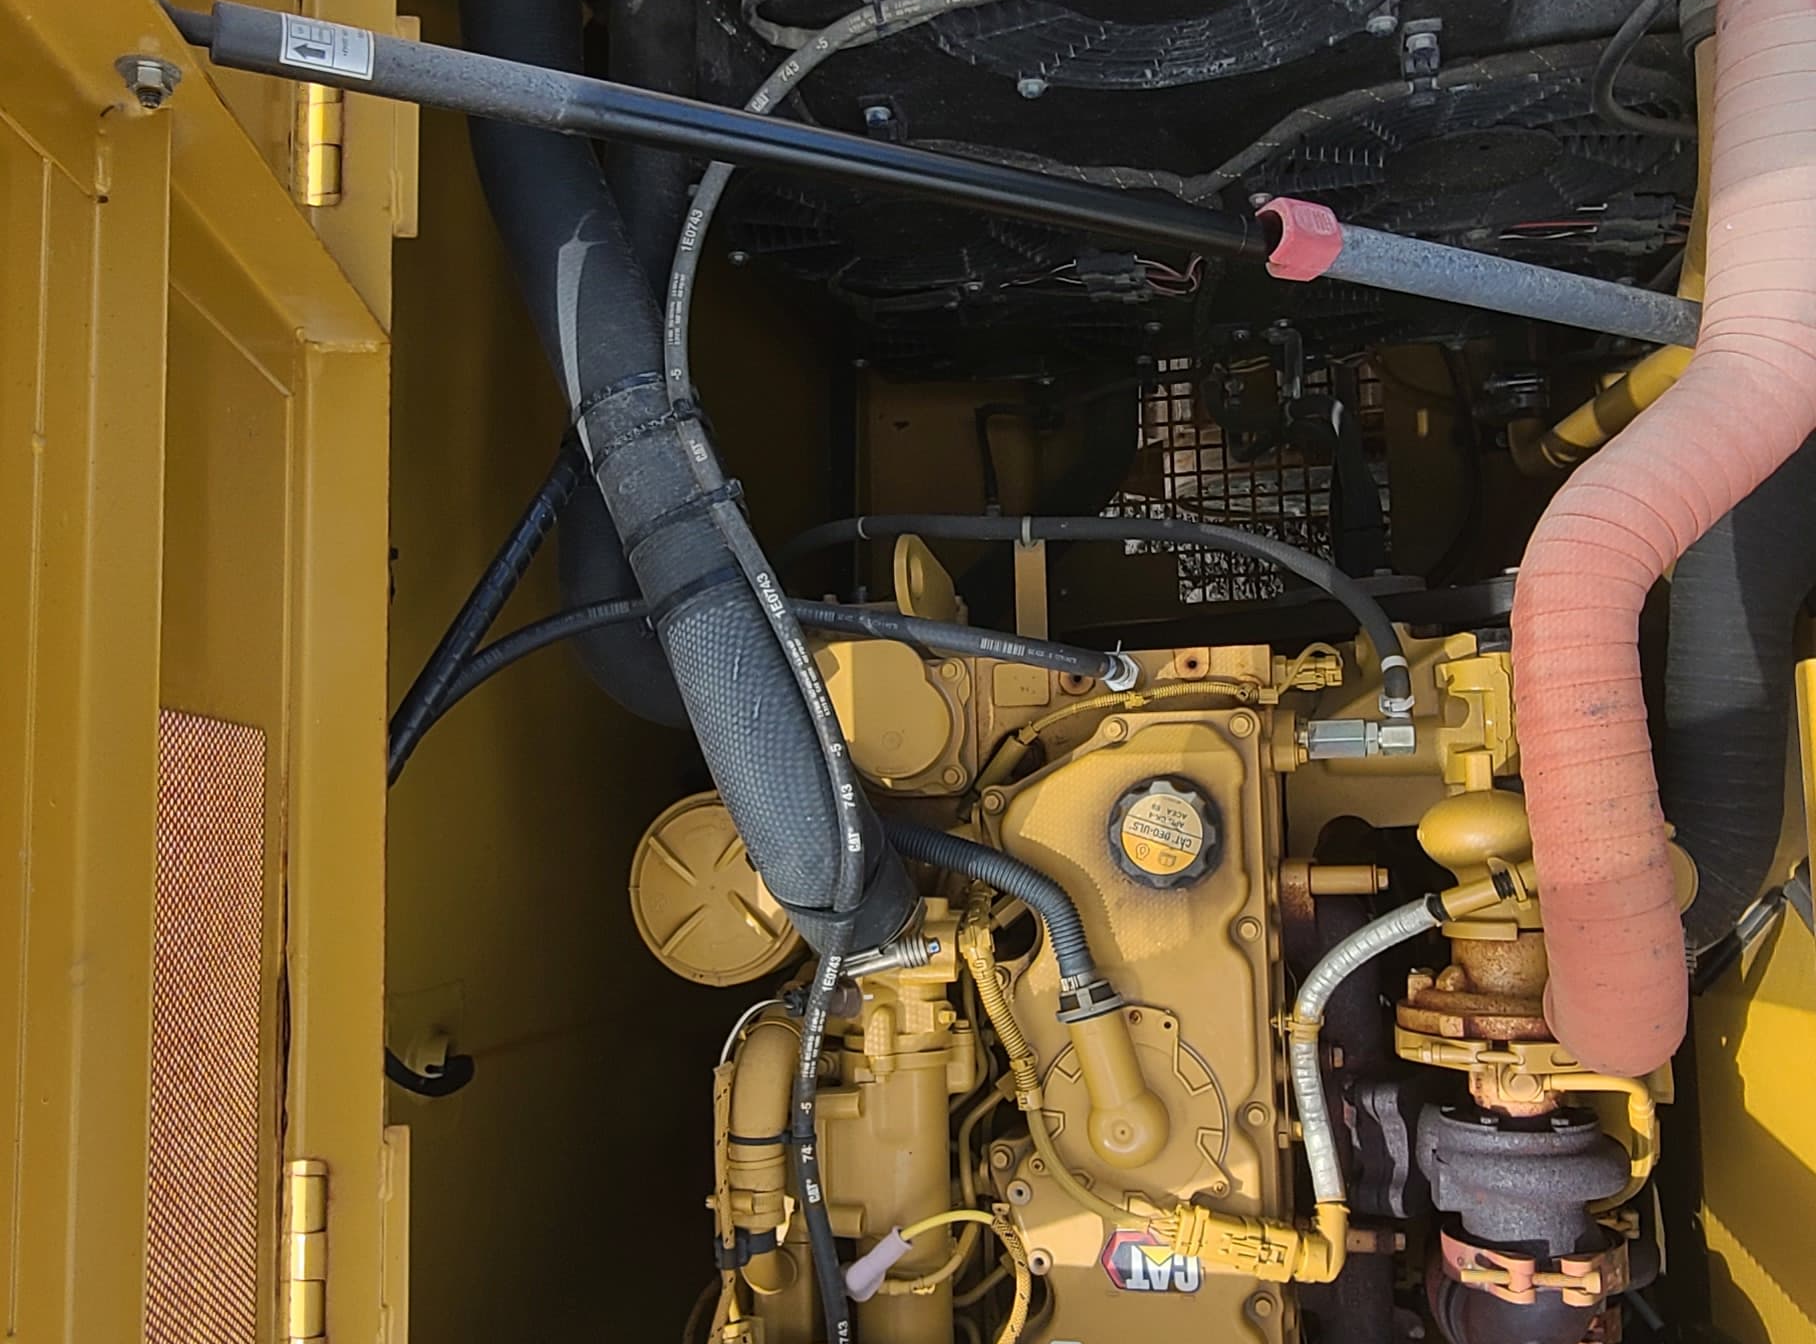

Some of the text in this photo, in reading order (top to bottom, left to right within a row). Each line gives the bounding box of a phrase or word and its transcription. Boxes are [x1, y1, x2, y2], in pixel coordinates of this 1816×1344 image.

[778, 60, 800, 82] 743
[815, 37, 829, 50] -5
[681, 209, 704, 252] 1E0743
[756, 572, 786, 619] 1E0743
[829, 743, 843, 757] -5
[841, 783, 856, 810] 743
[801, 1102, 812, 1114] -5
[821, 955, 842, 992] 1E0743
[1125, 1244, 1200, 1292] CAT
